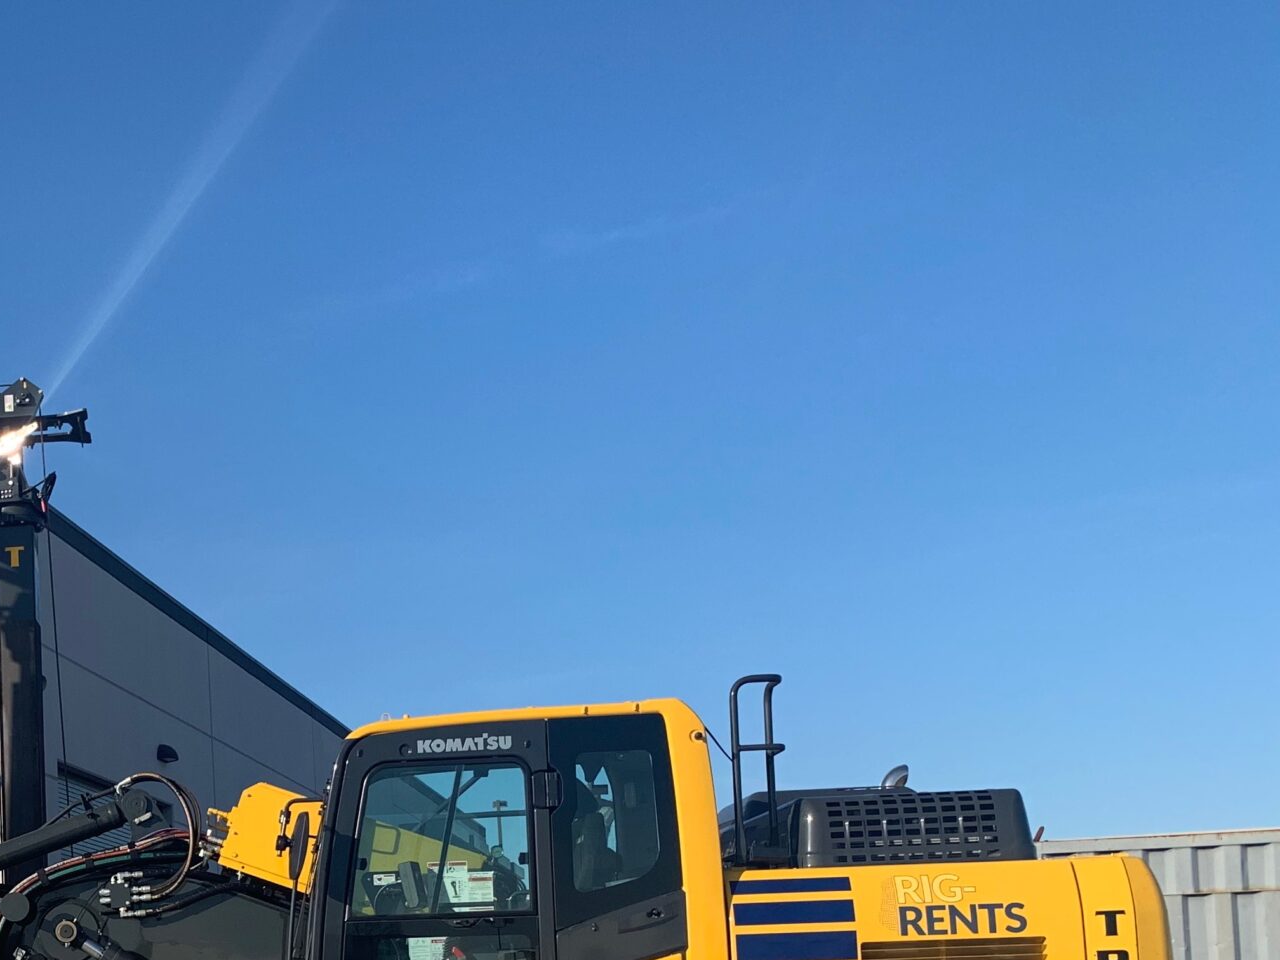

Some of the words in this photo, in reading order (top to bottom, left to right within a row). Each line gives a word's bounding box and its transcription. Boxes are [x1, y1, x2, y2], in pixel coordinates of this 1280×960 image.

[417, 733, 512, 753] KOMATSU
[893, 873, 976, 904] RIG-
[898, 902, 1028, 937] RENTS
